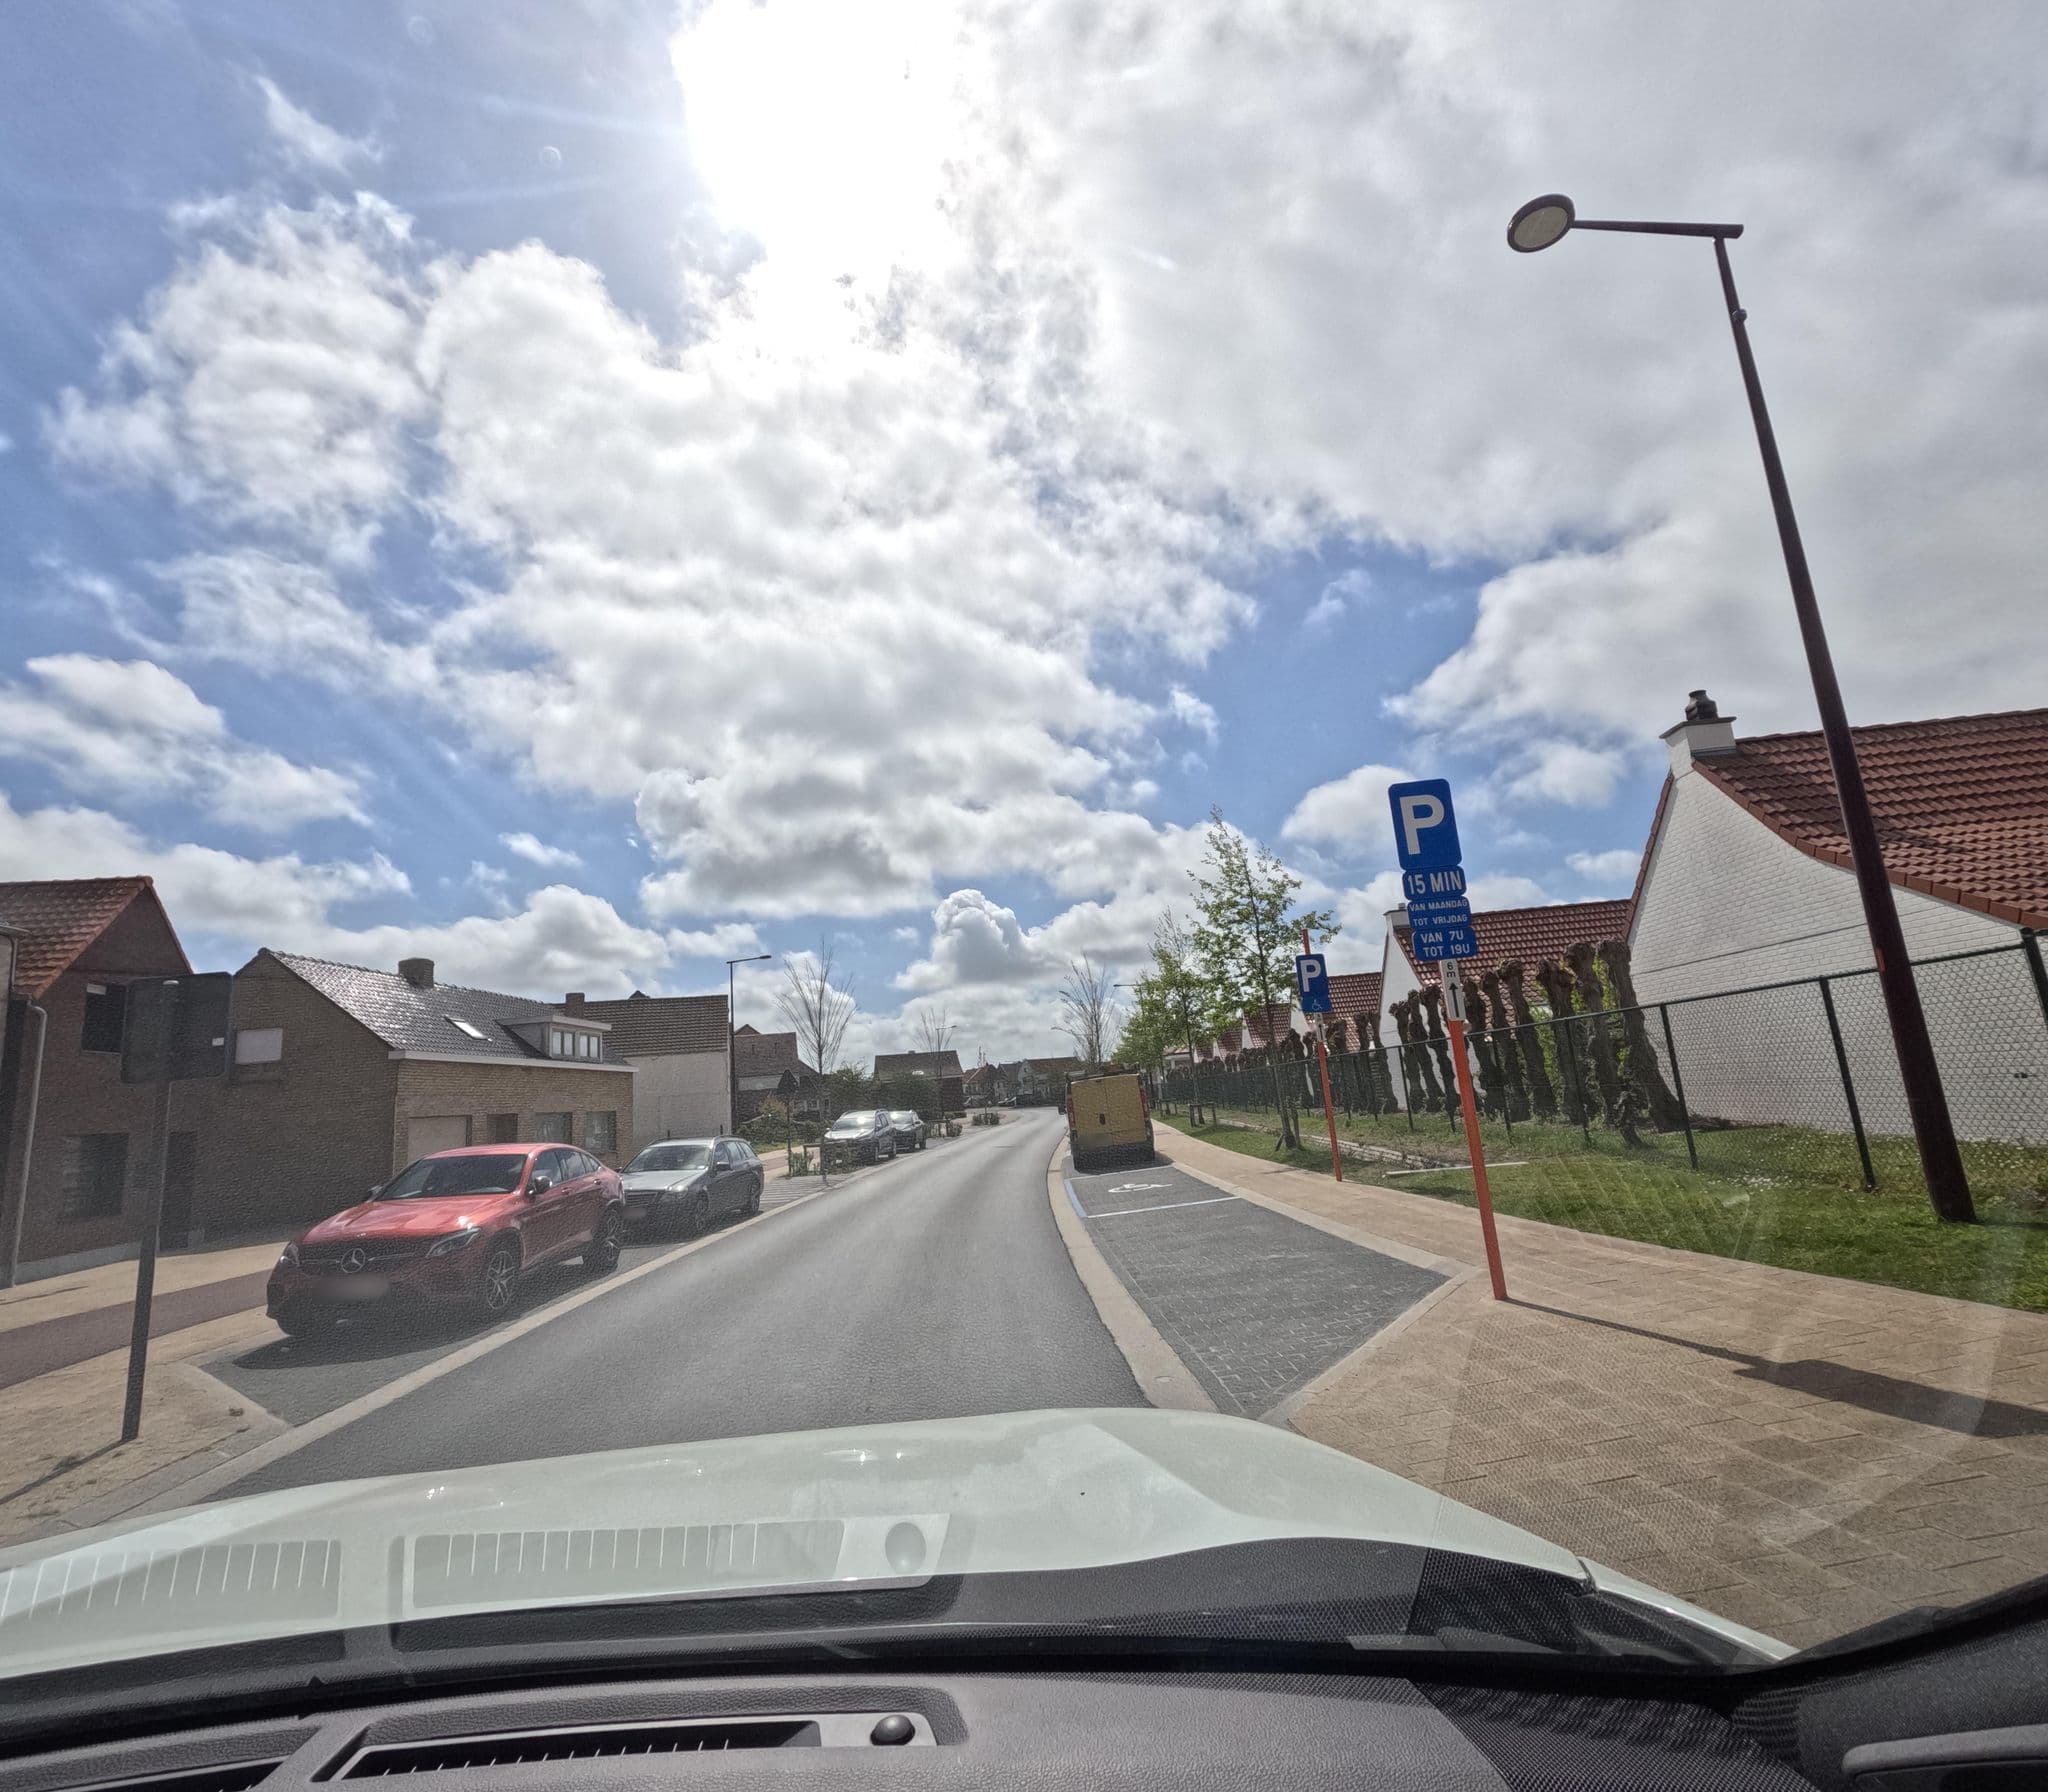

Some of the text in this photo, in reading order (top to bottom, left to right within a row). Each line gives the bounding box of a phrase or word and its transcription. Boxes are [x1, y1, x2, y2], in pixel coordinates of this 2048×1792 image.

[1400, 794, 1445, 855] P
[1407, 871, 1463, 895] 15 MIN
[1410, 899, 1468, 912] VAN MAANDAG
[1413, 914, 1468, 926] TOT VRIJDAG
[1420, 929, 1464, 944] VAN 7U
[1423, 943, 1470, 957] TOT 19U
[1447, 962, 1453, 970] 6
[1300, 959, 1321, 992] P
